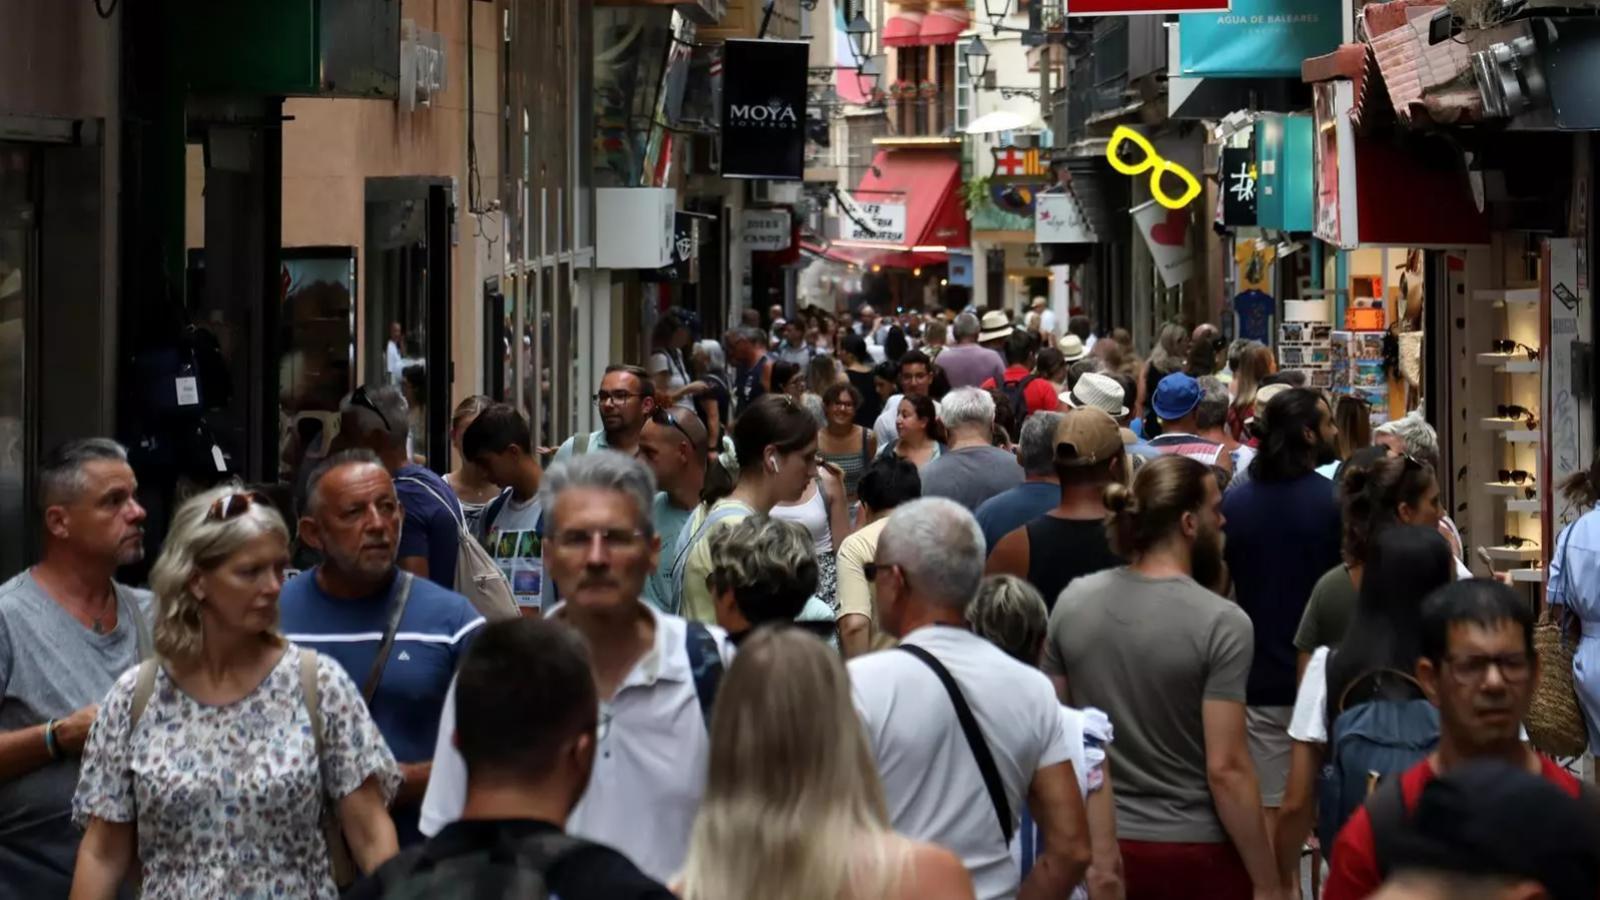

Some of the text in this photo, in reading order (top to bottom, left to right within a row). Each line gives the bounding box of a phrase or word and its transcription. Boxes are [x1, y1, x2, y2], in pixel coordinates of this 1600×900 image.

[1217, 13, 1320, 25] AGUA DE BALEARES
[730, 103, 796, 121] MOYA
